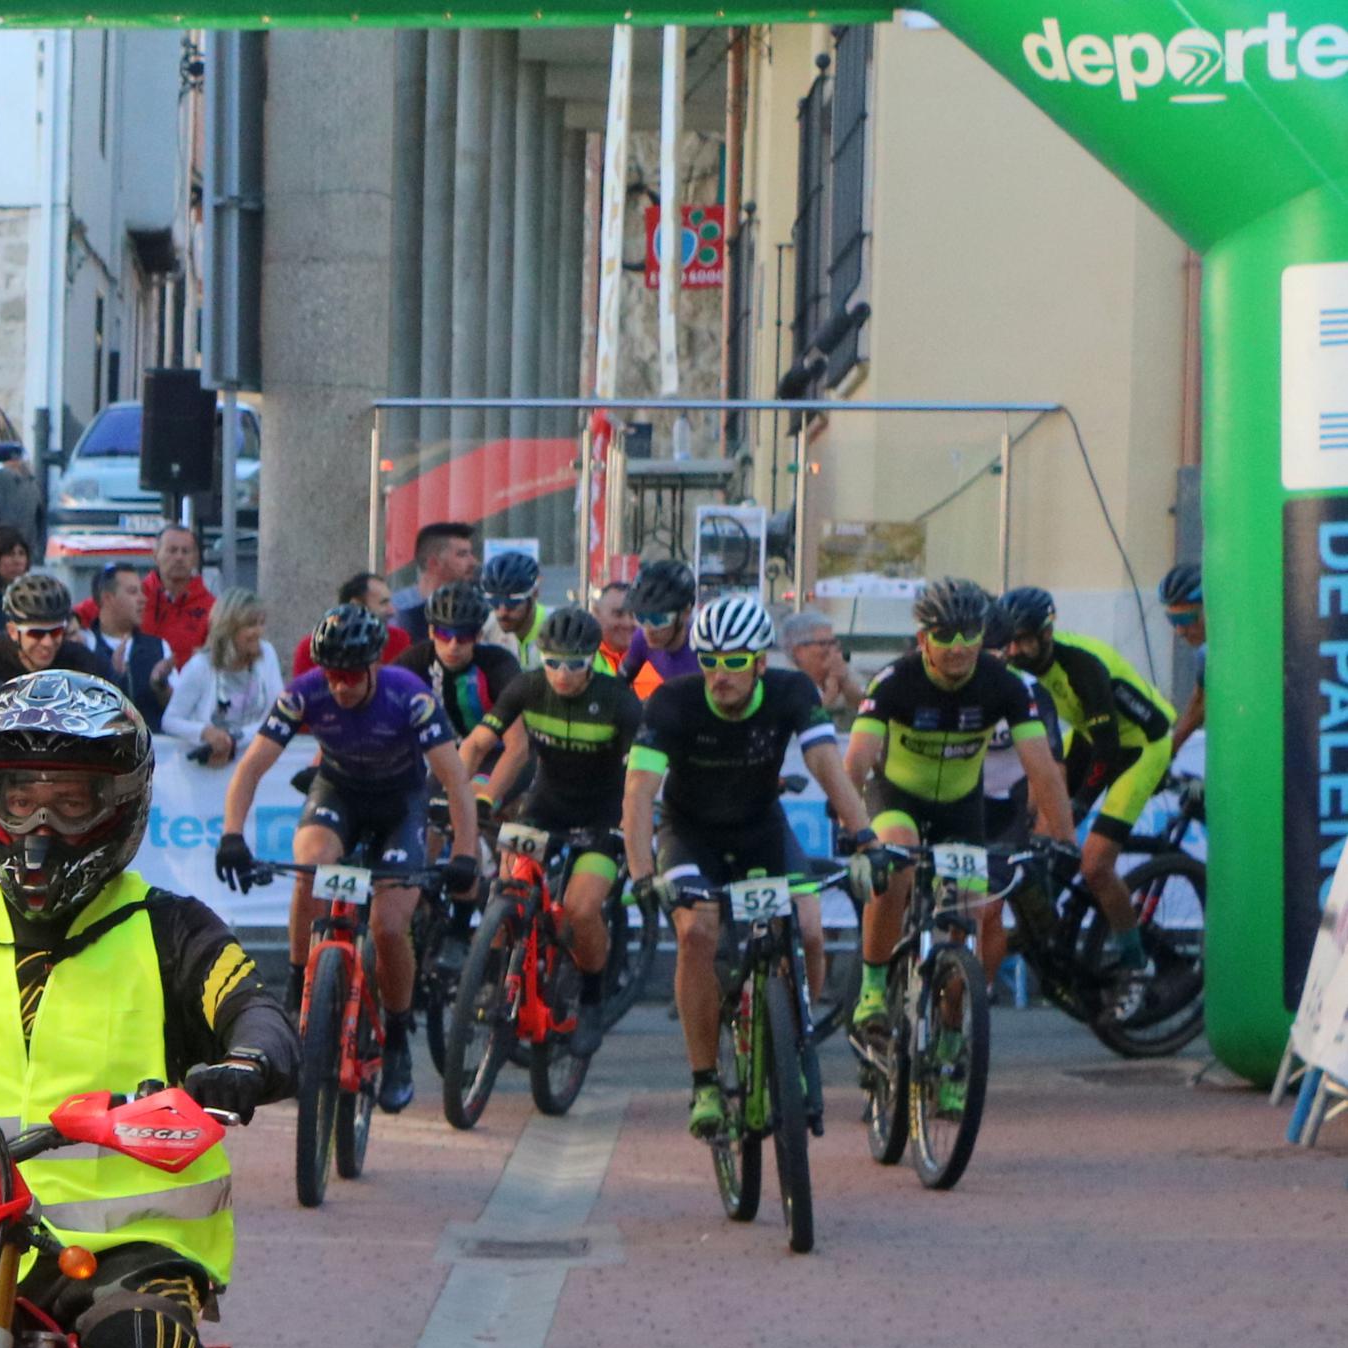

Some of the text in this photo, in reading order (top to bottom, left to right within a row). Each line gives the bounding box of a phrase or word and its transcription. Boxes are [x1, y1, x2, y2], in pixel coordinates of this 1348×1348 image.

[1022, 12, 1348, 101] deporte
[149, 807, 227, 848] tes
[945, 852, 976, 875] 38
[324, 873, 357, 893] 44
[744, 887, 779, 911] 52
